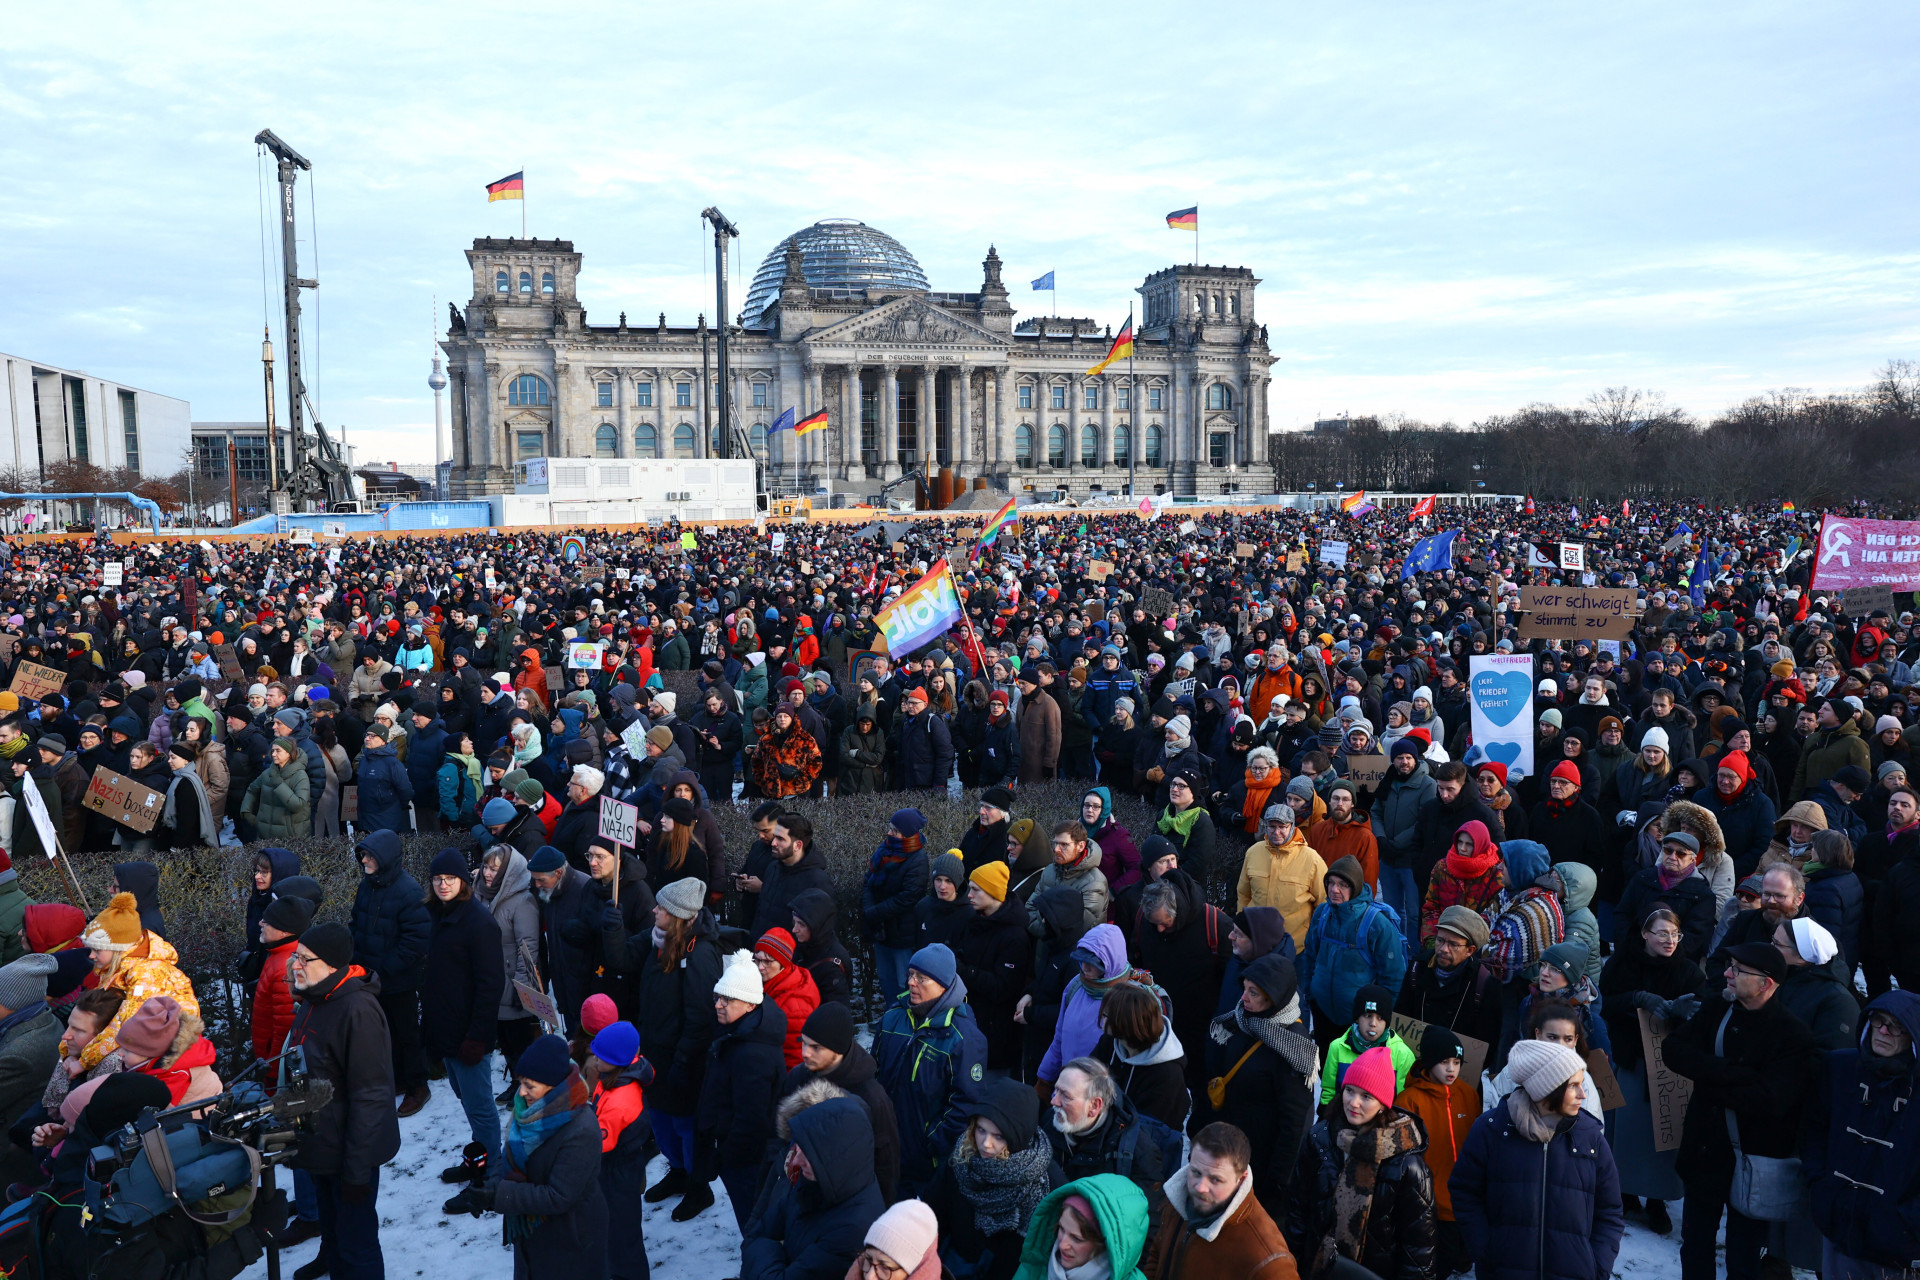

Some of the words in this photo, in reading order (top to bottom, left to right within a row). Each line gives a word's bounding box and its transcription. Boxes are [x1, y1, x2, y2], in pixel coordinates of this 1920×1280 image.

[1564, 549, 1578, 557] FCK
[1564, 556, 1579, 564] NZS
[1532, 596, 1561, 606] wer
[1565, 594, 1629, 612] schweigt
[1534, 613, 1577, 627] stimmt
[1490, 656, 1531, 664] WELTFRIEDEN
[18, 661, 33, 676] NIE
[34, 666, 64, 684] WIEDER
[30, 677, 41, 685] IST
[1479, 687, 1508, 696] FRIEDEN
[1480, 699, 1509, 709] FREIHEIT
[88, 775, 124, 805] Nazis
[123, 791, 158, 822] boxen
[602, 798, 623, 821] NO
[601, 817, 634, 843] NAZIS
[1395, 1012, 1423, 1042] Wir
[1648, 1013, 1669, 1081] GEGEN
[1657, 1081, 1676, 1144] RECHTS
